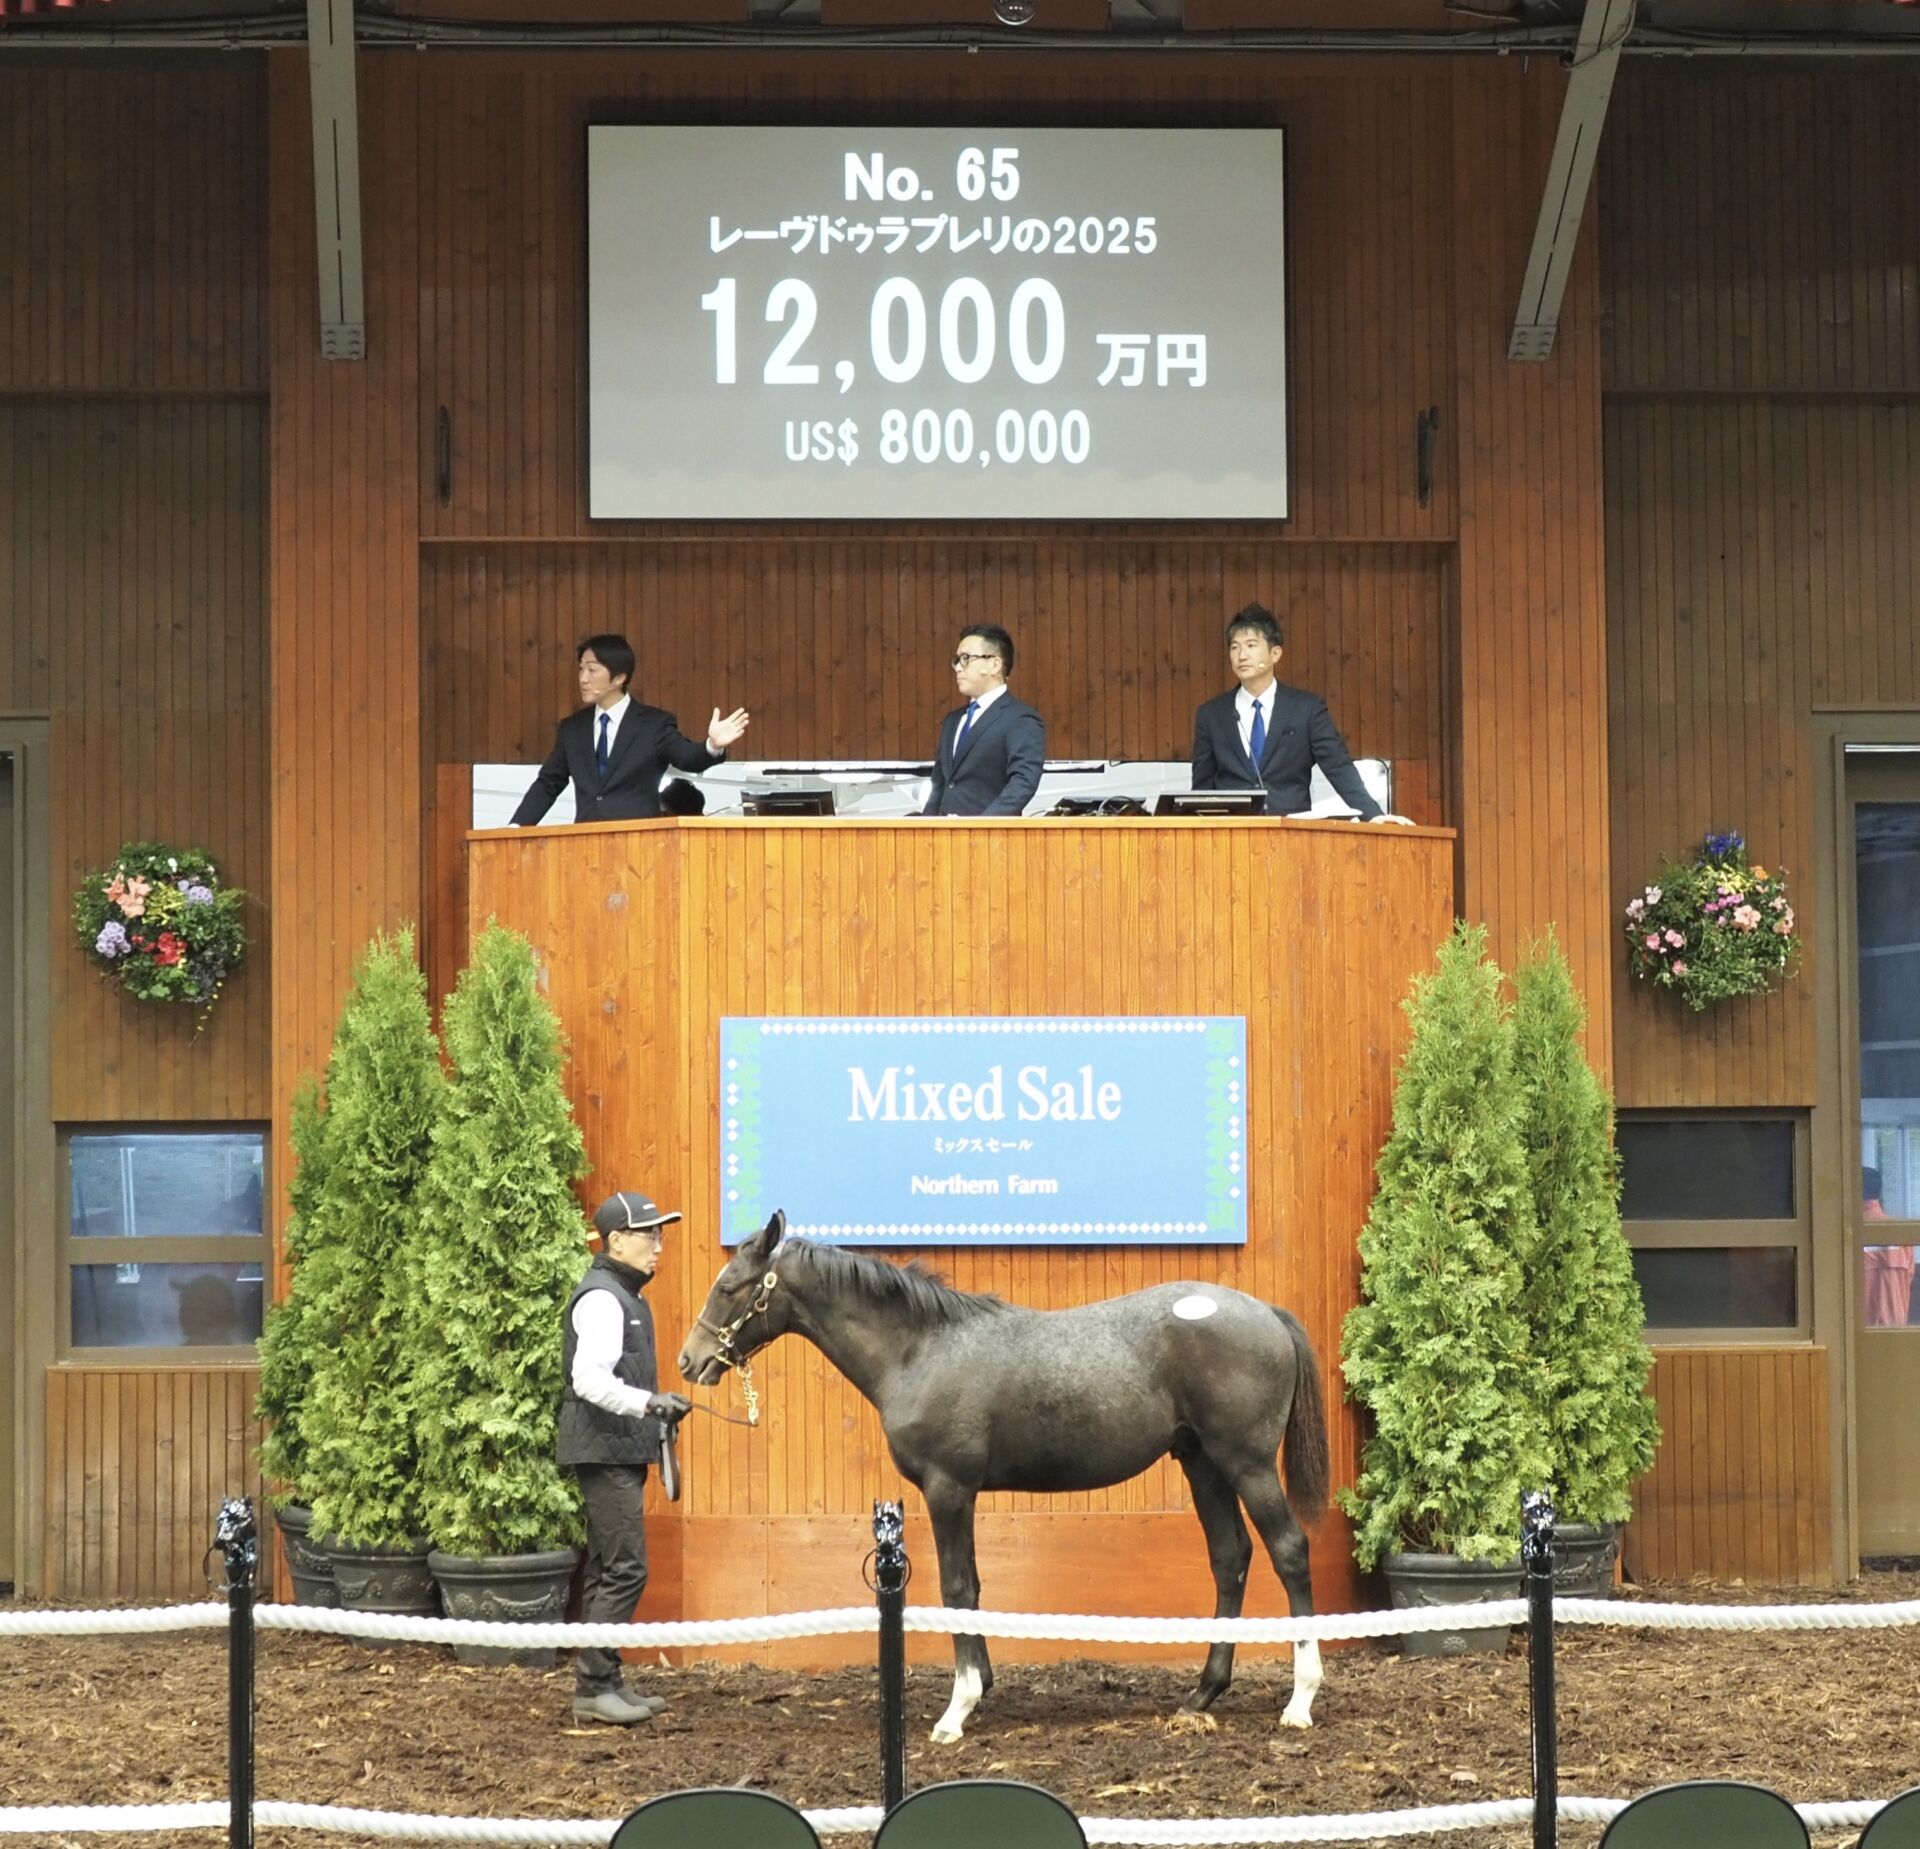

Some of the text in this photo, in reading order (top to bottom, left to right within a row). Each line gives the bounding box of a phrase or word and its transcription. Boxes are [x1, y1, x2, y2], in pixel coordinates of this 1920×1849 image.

[844, 147, 1020, 201] No. 65
[710, 213, 1157, 255] レーヴドゥラプレリの2025
[701, 276, 1207, 394] 12,000 万円
[786, 408, 1091, 468] US$ 800,000
[847, 1064, 1122, 1122] Mixed Sale
[911, 1173, 1058, 1195] Northern Farm
